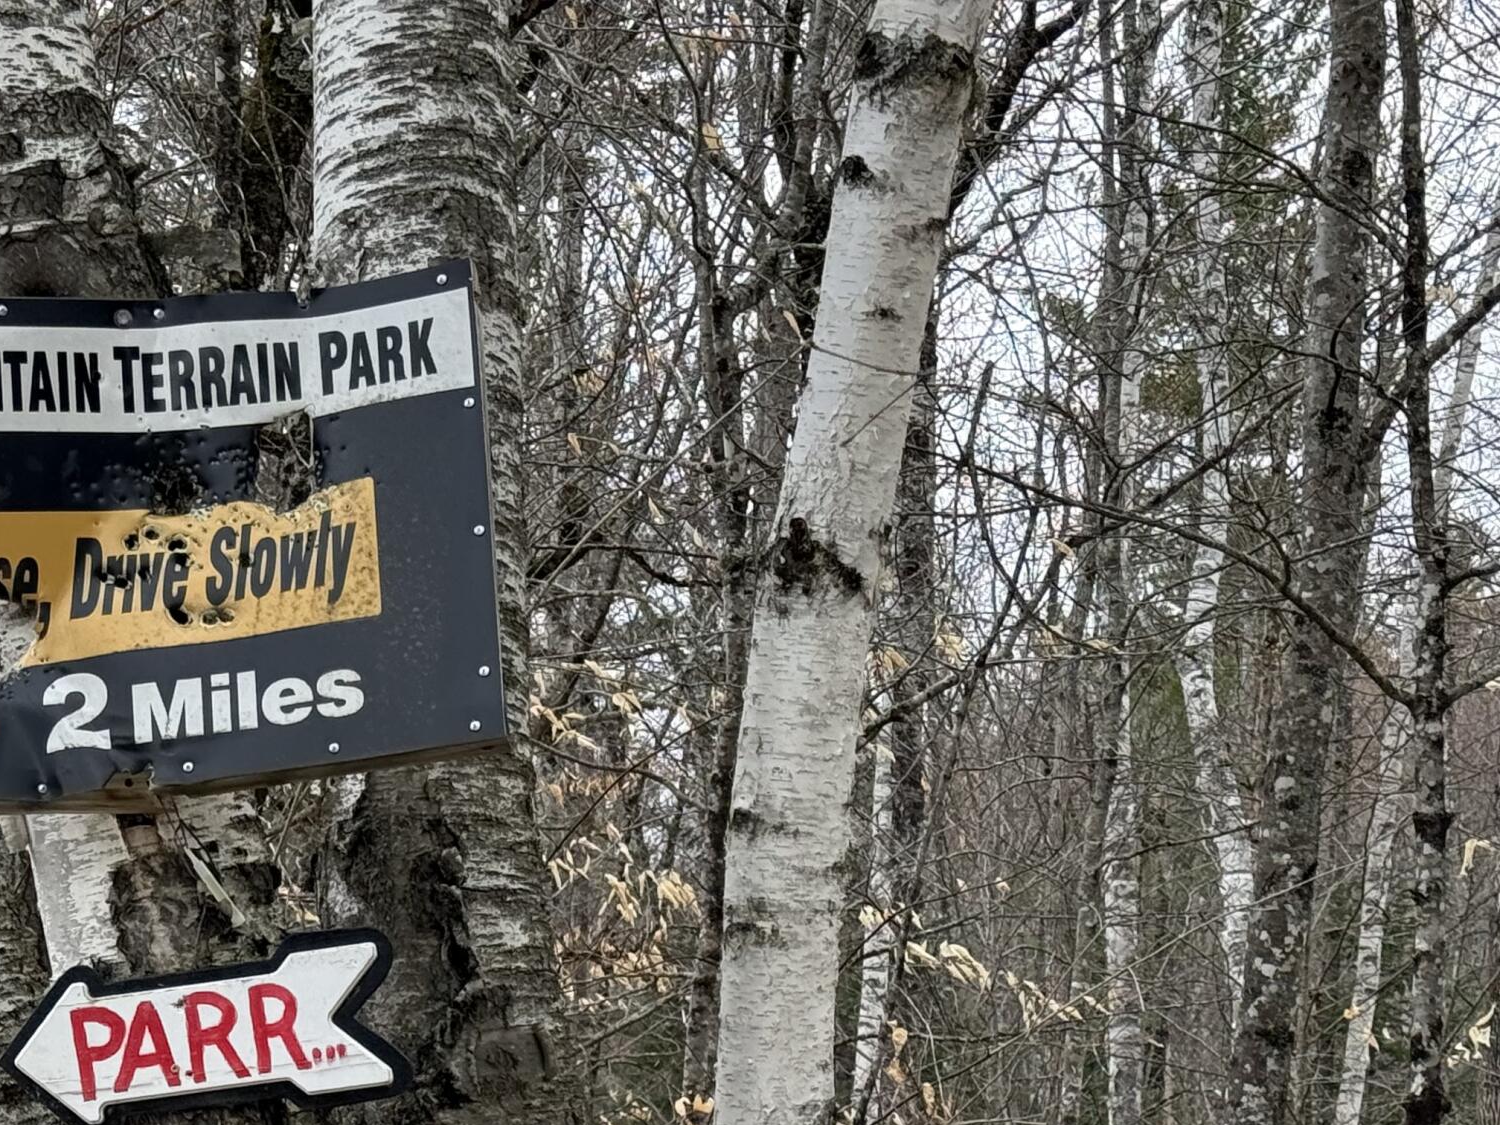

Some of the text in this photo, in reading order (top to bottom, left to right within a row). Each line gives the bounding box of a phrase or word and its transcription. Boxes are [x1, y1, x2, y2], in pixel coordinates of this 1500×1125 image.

[113, 341, 303, 414] TERRAIN
[318, 317, 438, 397] PARK
[69, 536, 190, 620] Drive
[205, 509, 357, 607] Slowly
[42, 668, 365, 755] 2 Miles
